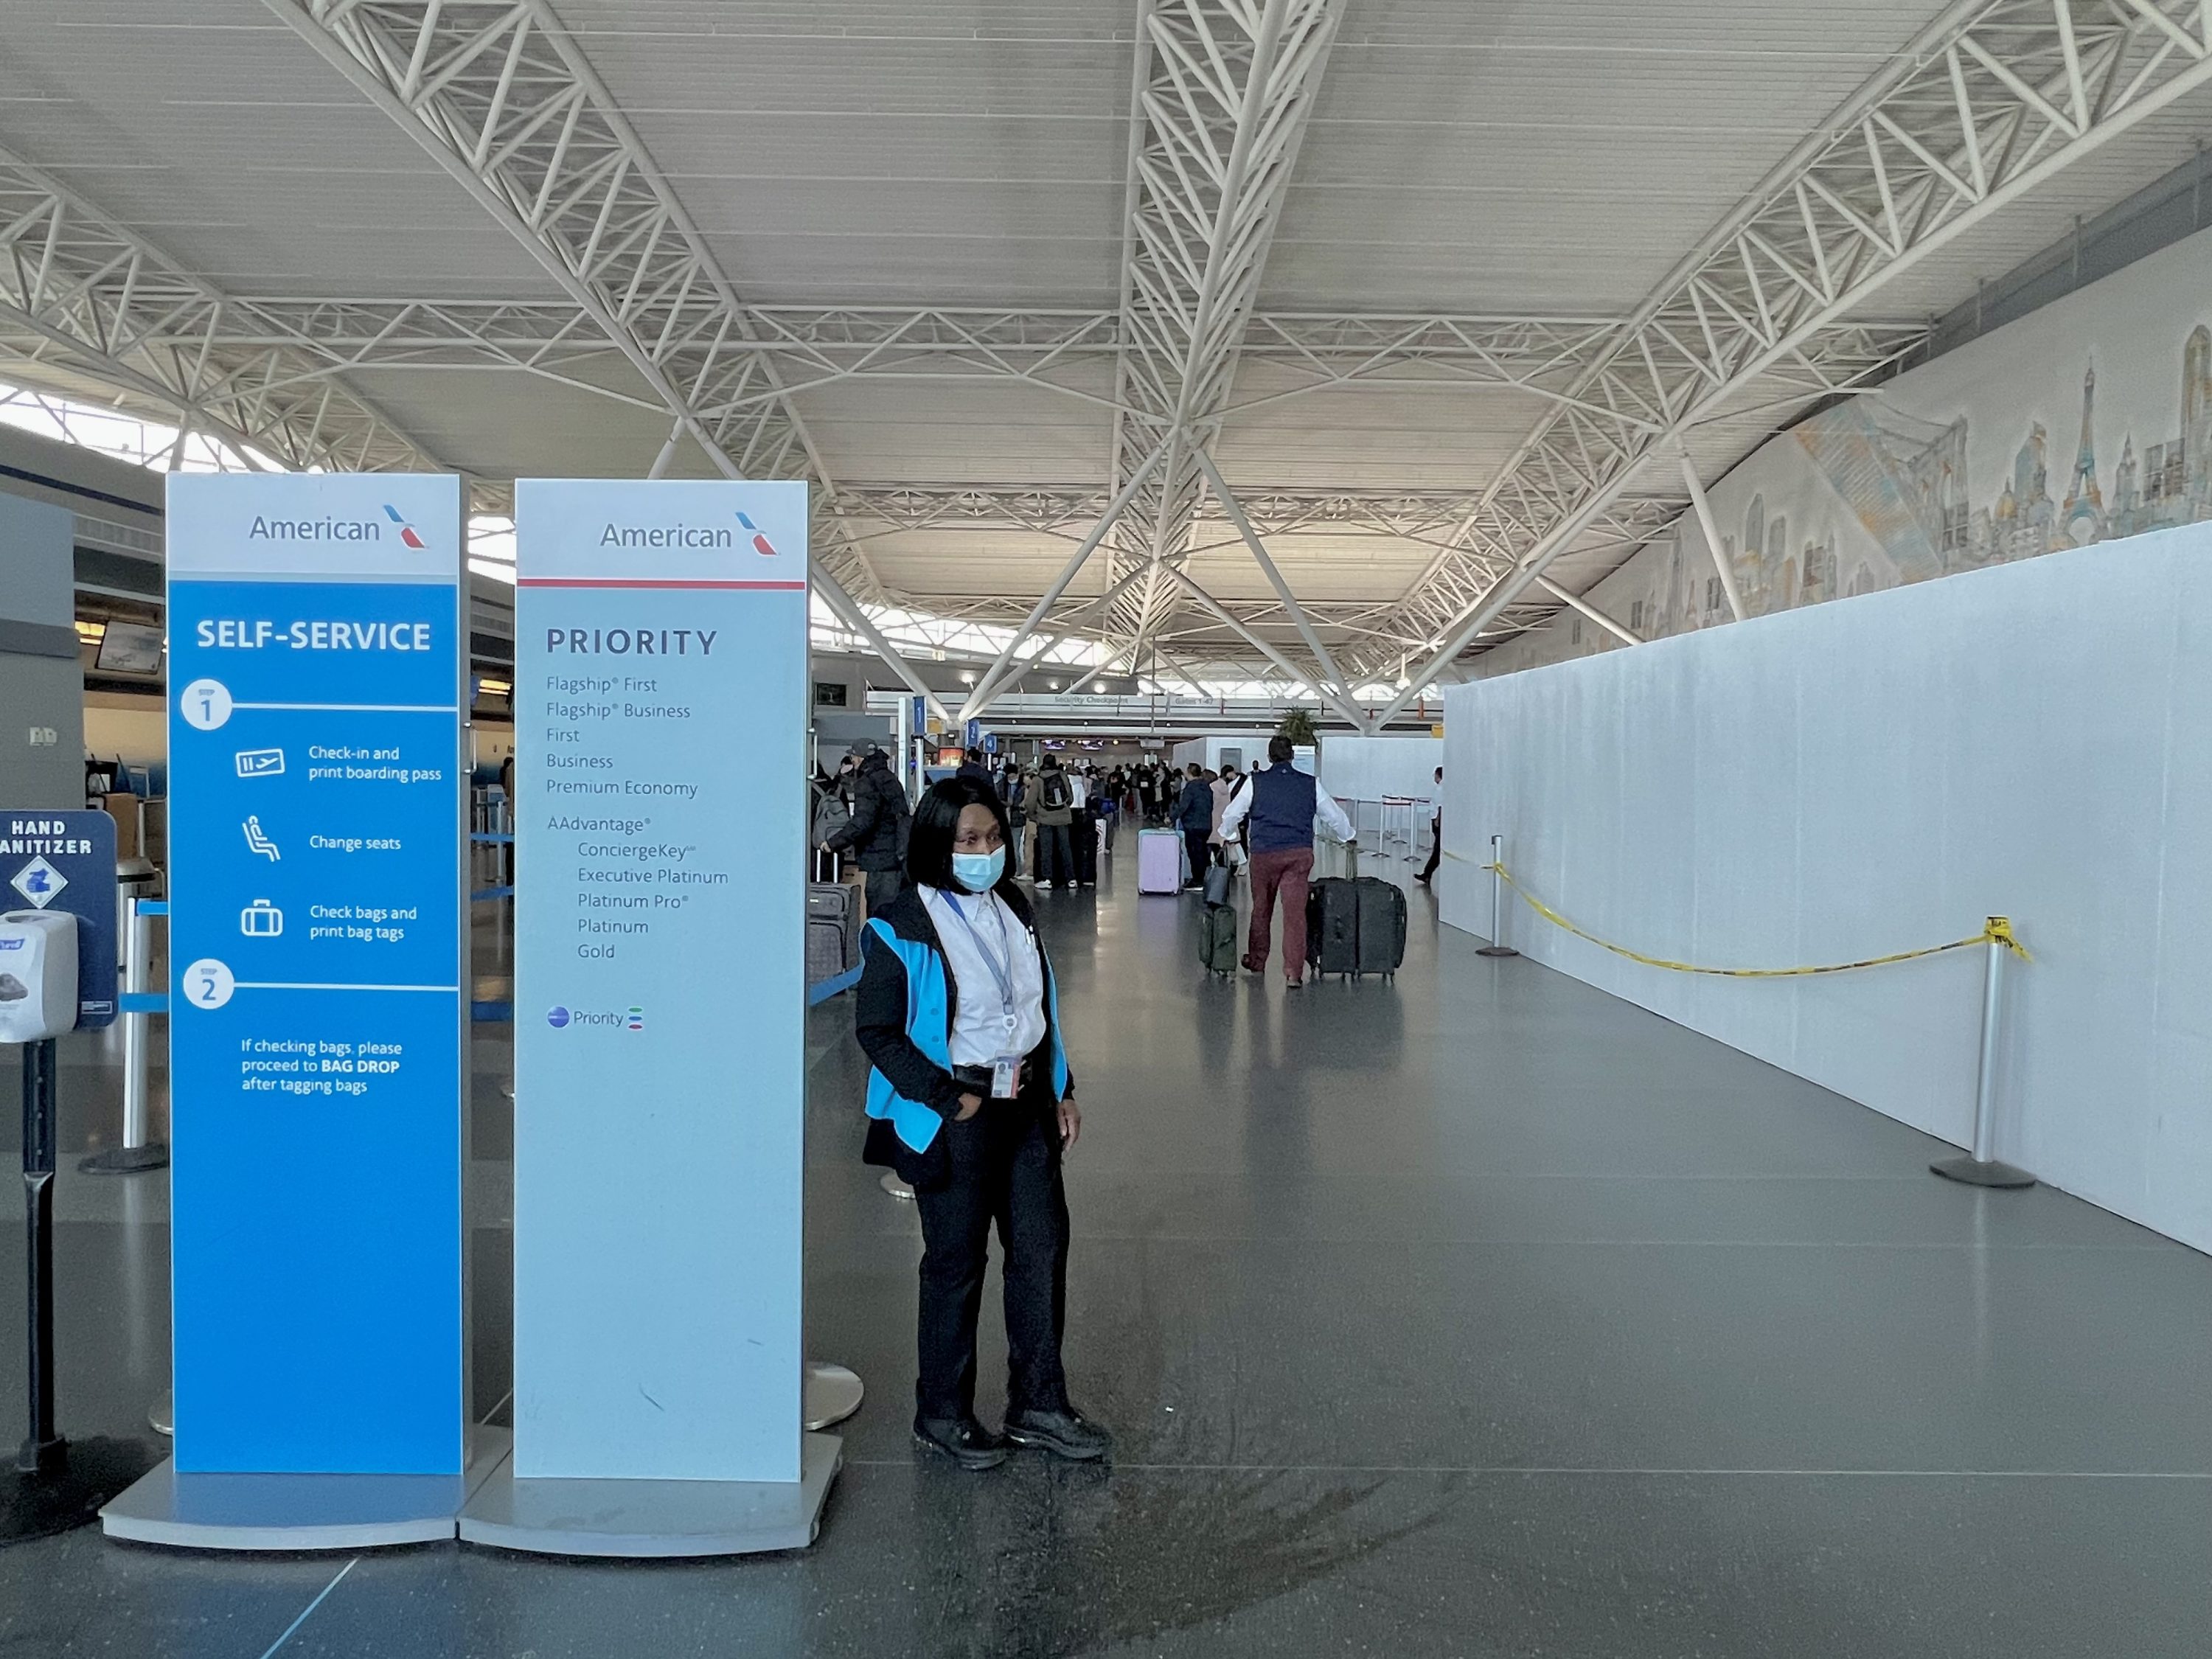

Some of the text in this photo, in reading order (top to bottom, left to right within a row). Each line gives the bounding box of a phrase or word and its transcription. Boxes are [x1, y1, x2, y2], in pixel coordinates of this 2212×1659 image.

[249, 515, 380, 540] American
[600, 523, 731, 548] American
[197, 619, 431, 650] SELF-SERVICE
[547, 629, 717, 655] PRIORITY
[625, 677, 657, 692] First
[201, 700, 210, 721] 1
[625, 703, 690, 718] Business
[547, 728, 580, 742] First
[309, 745, 400, 760] Check-in and
[547, 753, 613, 769] Business
[309, 766, 442, 784] print boarding pass
[547, 779, 698, 800] Premium Economy
[11, 821, 66, 835] HAND
[0, 839, 92, 854] ANITIZER
[310, 835, 402, 853] Change seats
[578, 867, 728, 884] Executive Platinum
[578, 893, 649, 908] Platinum
[310, 905, 417, 923] Check bags and
[310, 925, 405, 942] print bag tags
[578, 918, 649, 933] Platinum
[577, 944, 615, 959] Gold
[202, 978, 217, 1001] 2
[574, 1010, 624, 1029] Priority
[241, 1038, 252, 1052] If
[254, 1039, 316, 1057] checking
[358, 1041, 403, 1057] please
[242, 1060, 400, 1074] proceed to BAG DROP
[241, 1077, 368, 1096] after tagging bags
